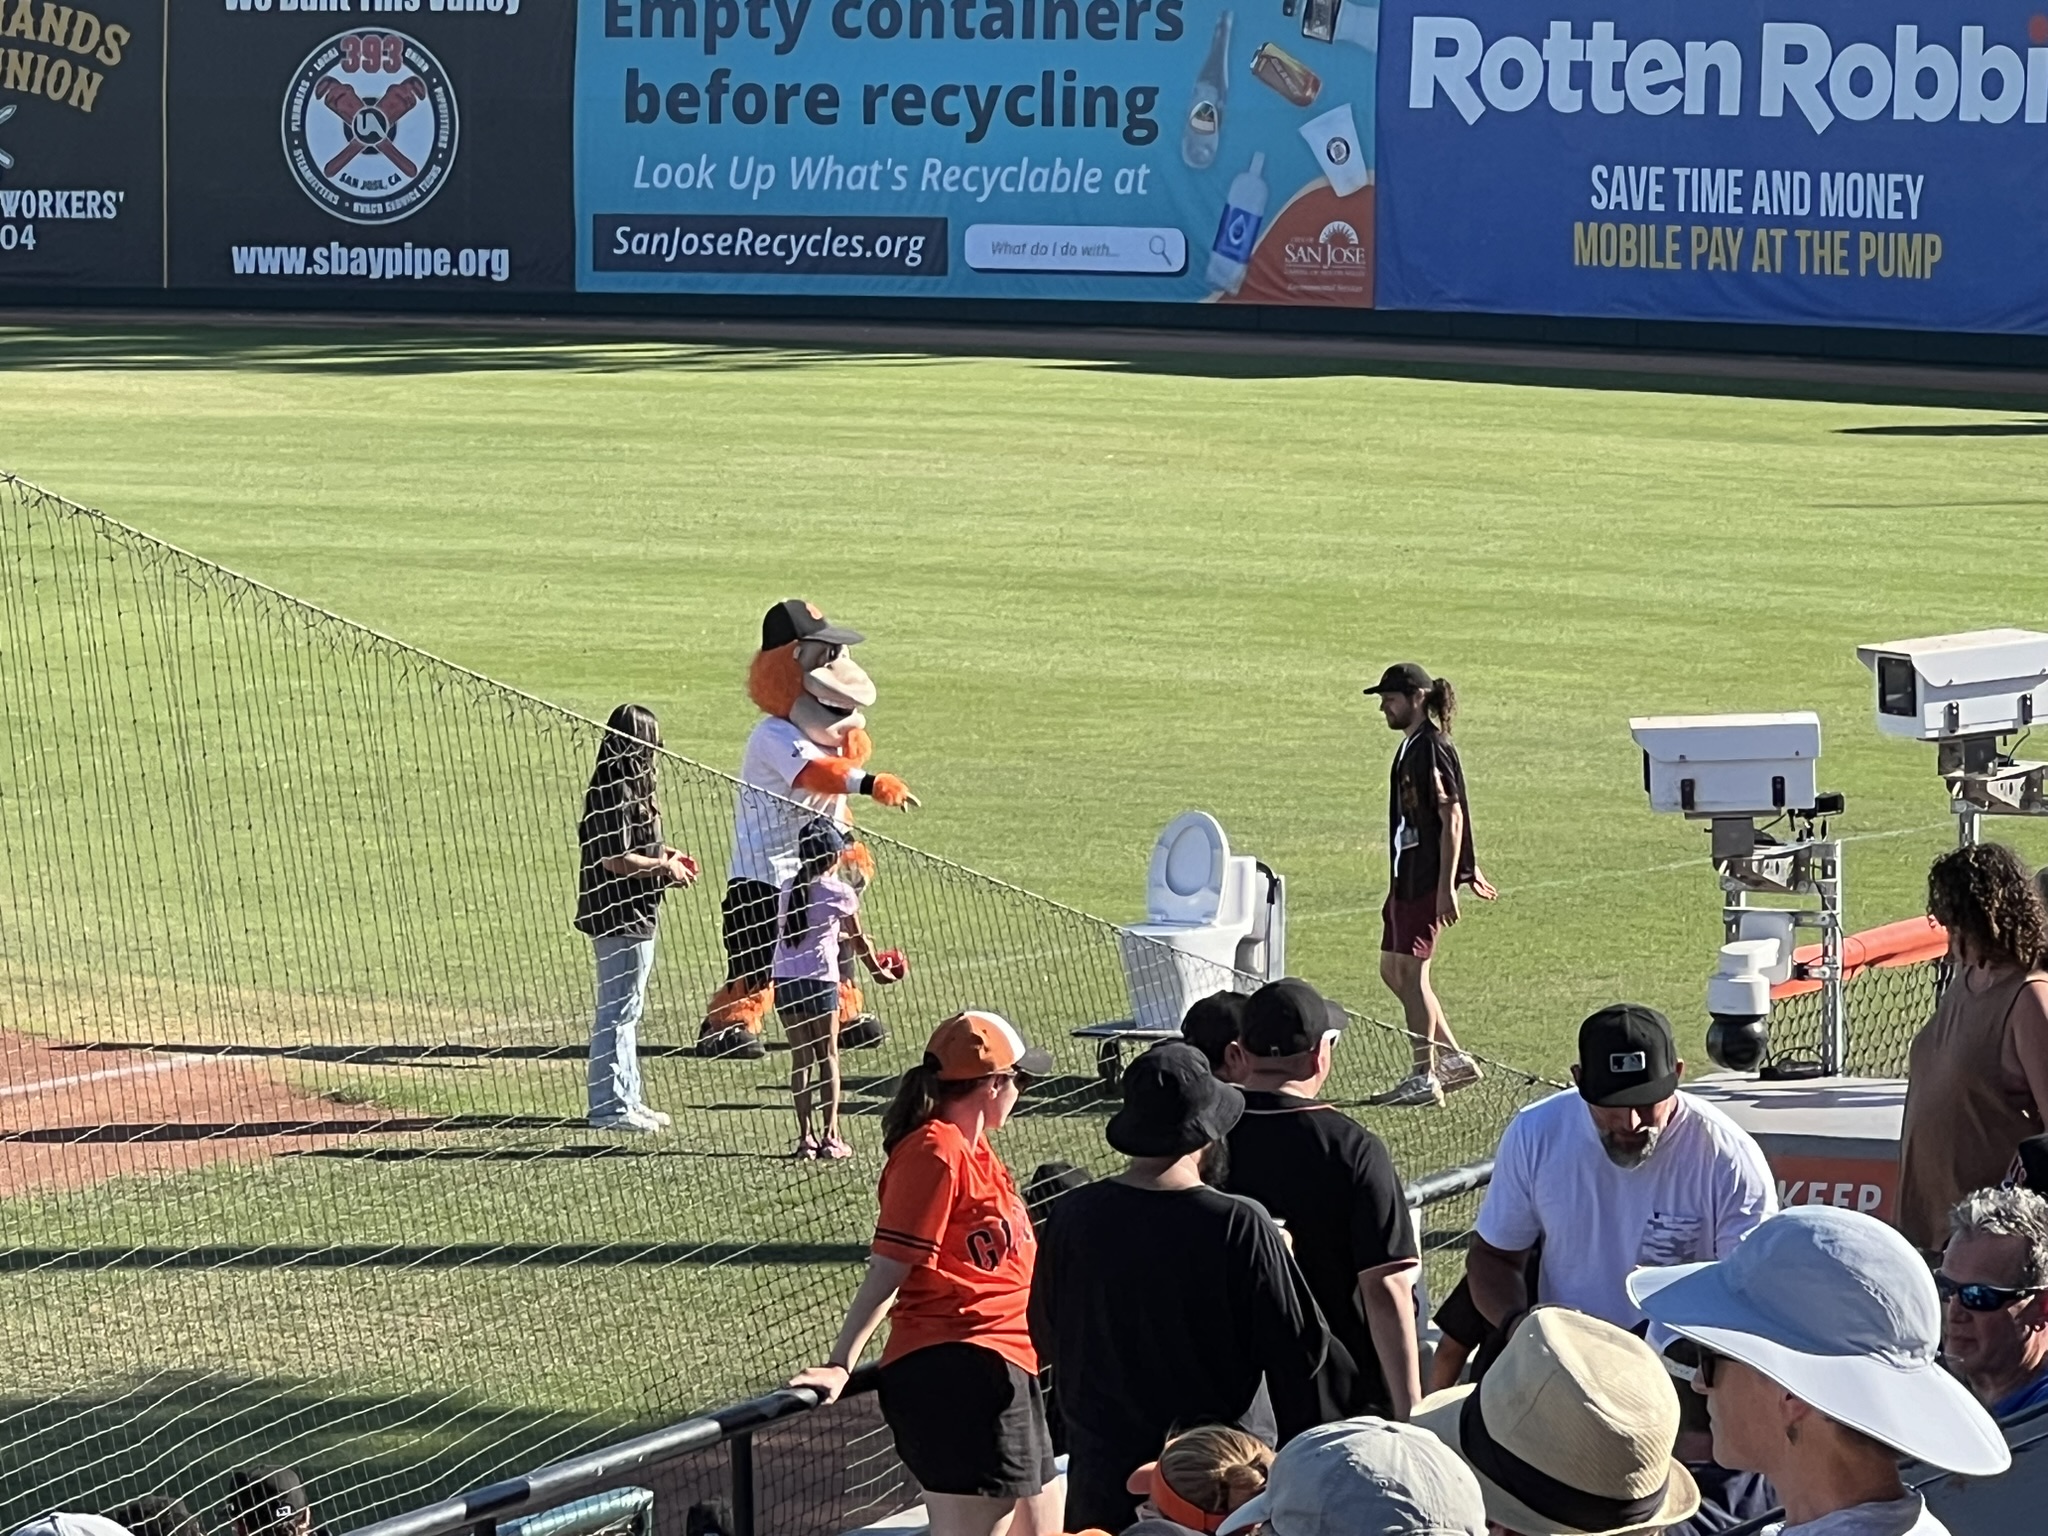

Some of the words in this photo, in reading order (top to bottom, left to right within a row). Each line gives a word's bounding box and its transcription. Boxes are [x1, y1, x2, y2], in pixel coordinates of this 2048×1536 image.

[0, 0, 130, 66] ANDS
[340, 34, 404, 73] 393
[604, 0, 812, 55] Empty
[832, 0, 1184, 41] containers
[0, 48, 104, 113] NION
[1409, 16, 1742, 125] Rotten
[625, 67, 840, 125] before
[863, 69, 1160, 146] recycling
[0, 190, 125, 219] WORKERS'
[633, 154, 717, 190] Look
[729, 156, 777, 200] Up
[790, 155, 908, 191] What's
[920, 157, 1103, 203] Recyclable
[1114, 163, 1151, 196] at
[1590, 165, 1665, 212] SAVE
[1673, 167, 1744, 214] TIME
[1751, 169, 1812, 216] AND
[1819, 172, 1925, 220] MONEY
[231, 242, 510, 281] www.sbaypipe.org
[612, 226, 926, 267] SanJoseRecycles.org
[991, 241, 1028, 256] What
[1030, 242, 1049, 256] do
[1060, 242, 1078, 256] do
[1285, 243, 1322, 263] SAN
[1322, 244, 1366, 269] JOSE
[1574, 221, 1682, 270] MOBILE
[1690, 226, 1744, 272] PAY
[1751, 228, 1788, 273] AT
[1795, 230, 1850, 275] THE
[1858, 232, 1942, 279] PUMP
